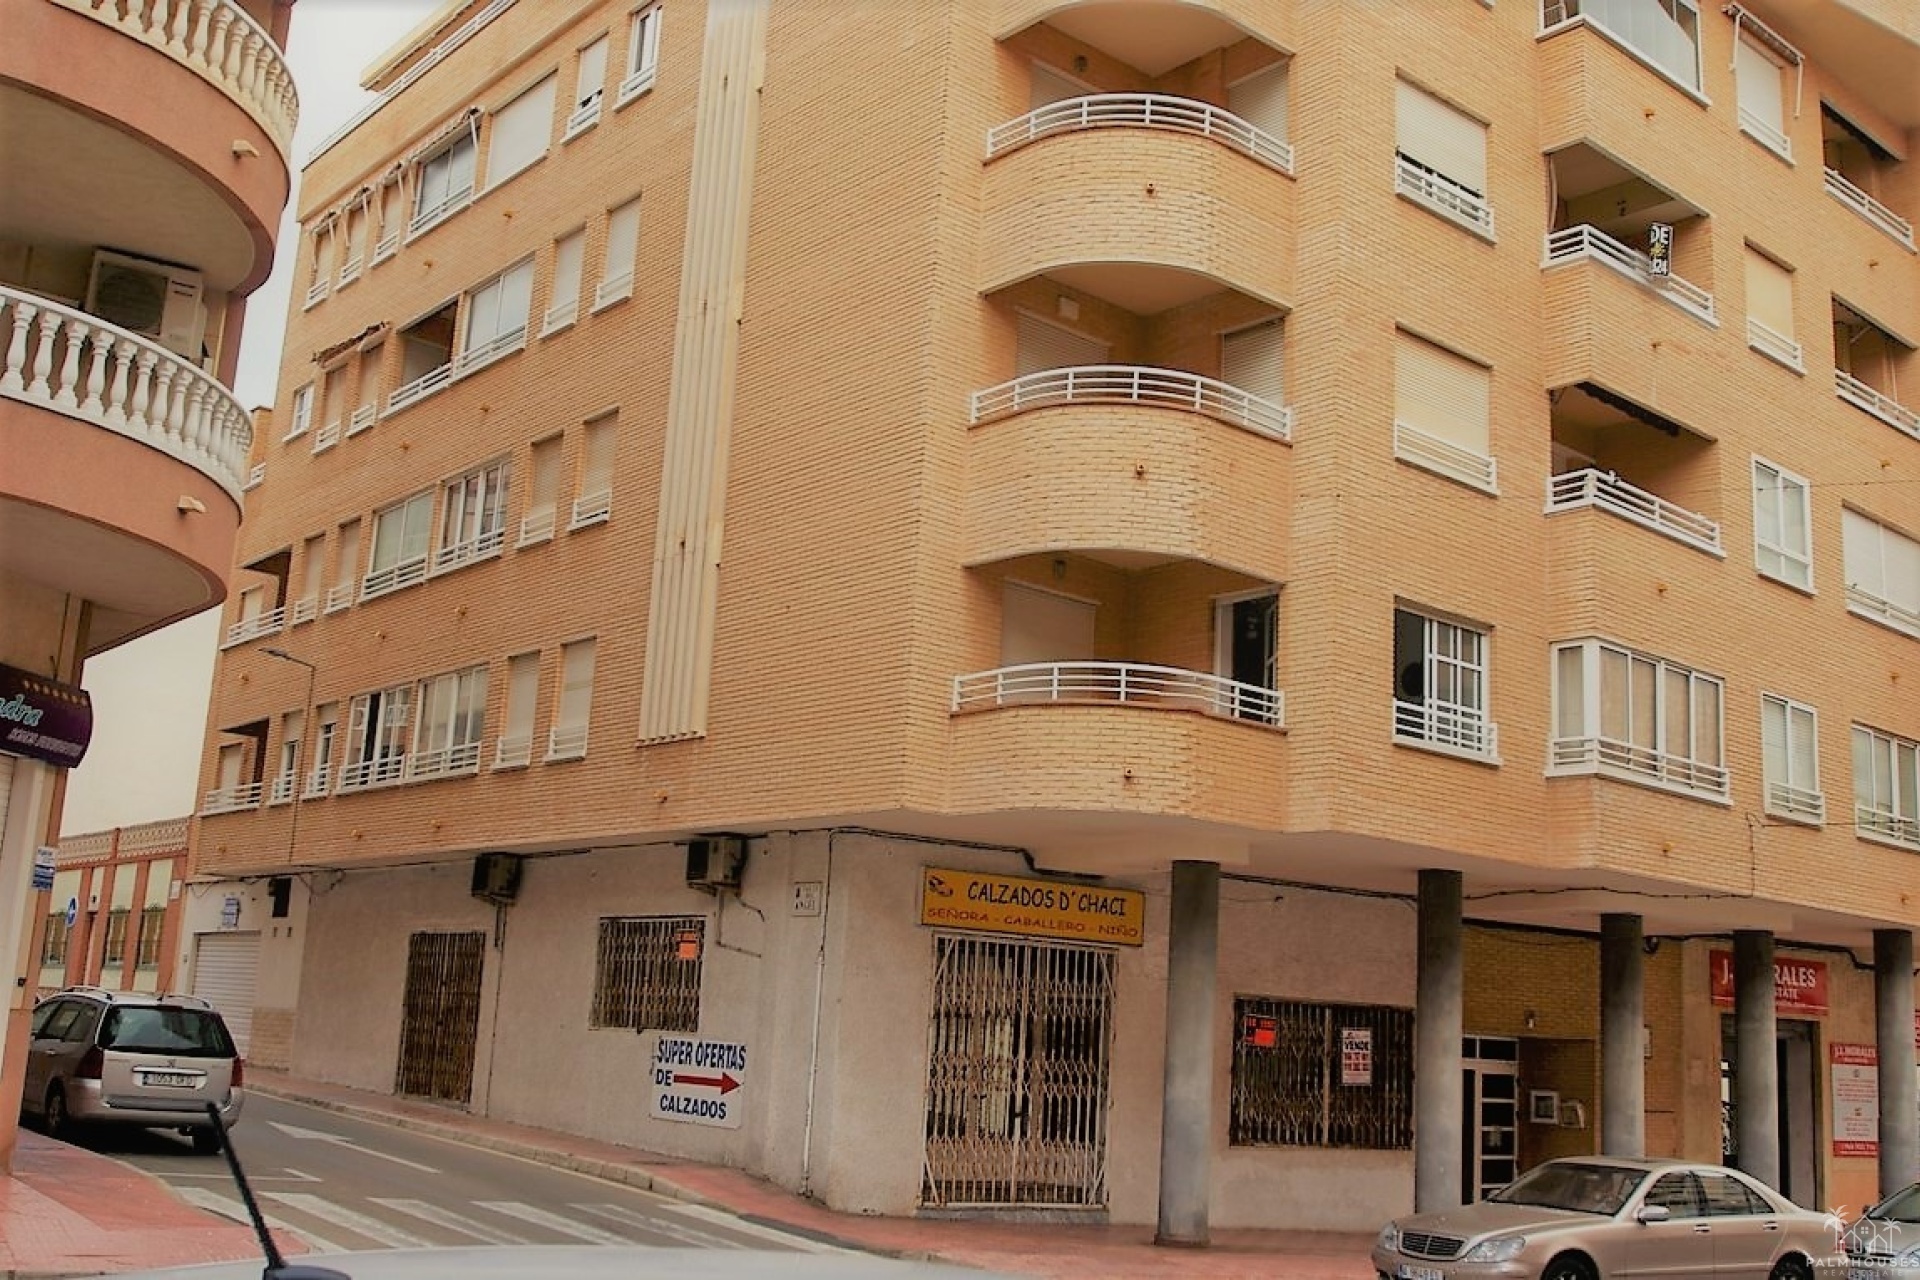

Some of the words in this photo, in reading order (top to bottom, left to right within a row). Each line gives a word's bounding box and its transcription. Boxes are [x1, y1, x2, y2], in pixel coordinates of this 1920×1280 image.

[967, 881, 1054, 909] CALZADOS
[928, 907, 989, 922] SEÑORA
[1004, 916, 1085, 933] CABALLERO
[1098, 924, 1138, 938] NIÑO
[658, 1039, 692, 1065] SUPER
[695, 1041, 746, 1071] OFERTAS
[655, 1068, 673, 1086] DE
[660, 1093, 727, 1119] CALZADOS
